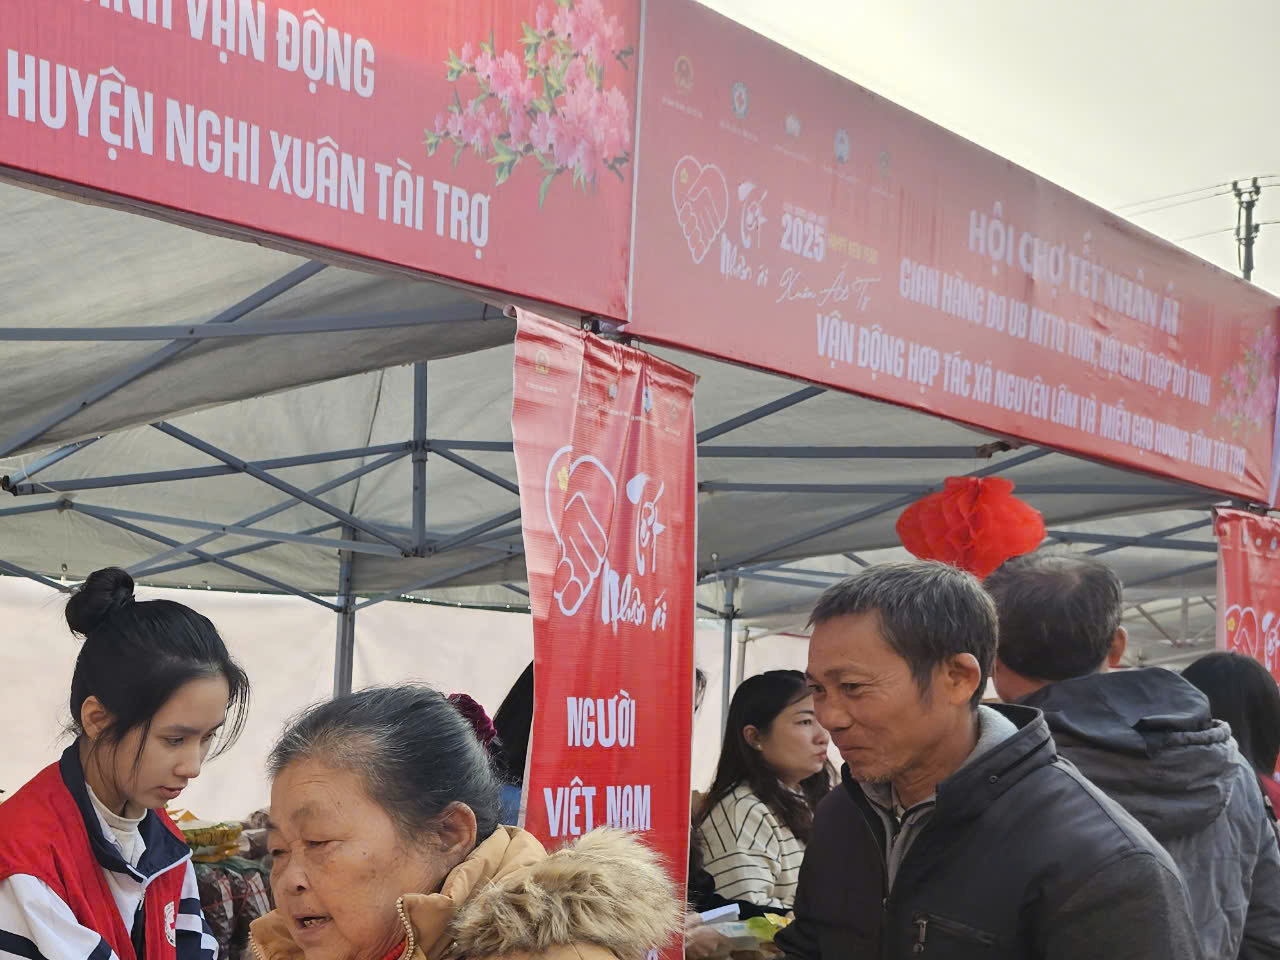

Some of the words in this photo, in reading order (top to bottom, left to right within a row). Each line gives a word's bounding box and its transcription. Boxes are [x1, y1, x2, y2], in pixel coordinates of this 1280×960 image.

[276, 9, 375, 99] ĐỘNG
[7, 49, 154, 161] HUYỆN
[166, 98, 260, 185] NGHI
[269, 129, 365, 215] XUÂN
[375, 157, 424, 231] TÀI
[432, 178, 490, 259] TRỢ
[781, 213, 825, 262] 2025
[969, 199, 1014, 276] HỘI
[1020, 231, 1065, 298] CHỢ
[1069, 231, 1104, 301] TẾT
[1104, 267, 1158, 328] NHÂN
[900, 257, 939, 309] GIAN
[941, 272, 984, 325] HÀNG
[985, 290, 1006, 332] DO
[1008, 298, 1028, 339] UB
[816, 310, 855, 369] VẬN
[858, 324, 905, 381] ĐỘNG
[908, 341, 940, 393] HỢP
[943, 351, 971, 398] TÁC
[972, 360, 993, 404] XÃ
[1050, 383, 1079, 428] LÂM
[1080, 393, 1097, 434] VÀ
[567, 689, 636, 748] NGƯỜI
[606, 784, 651, 831] NAM
